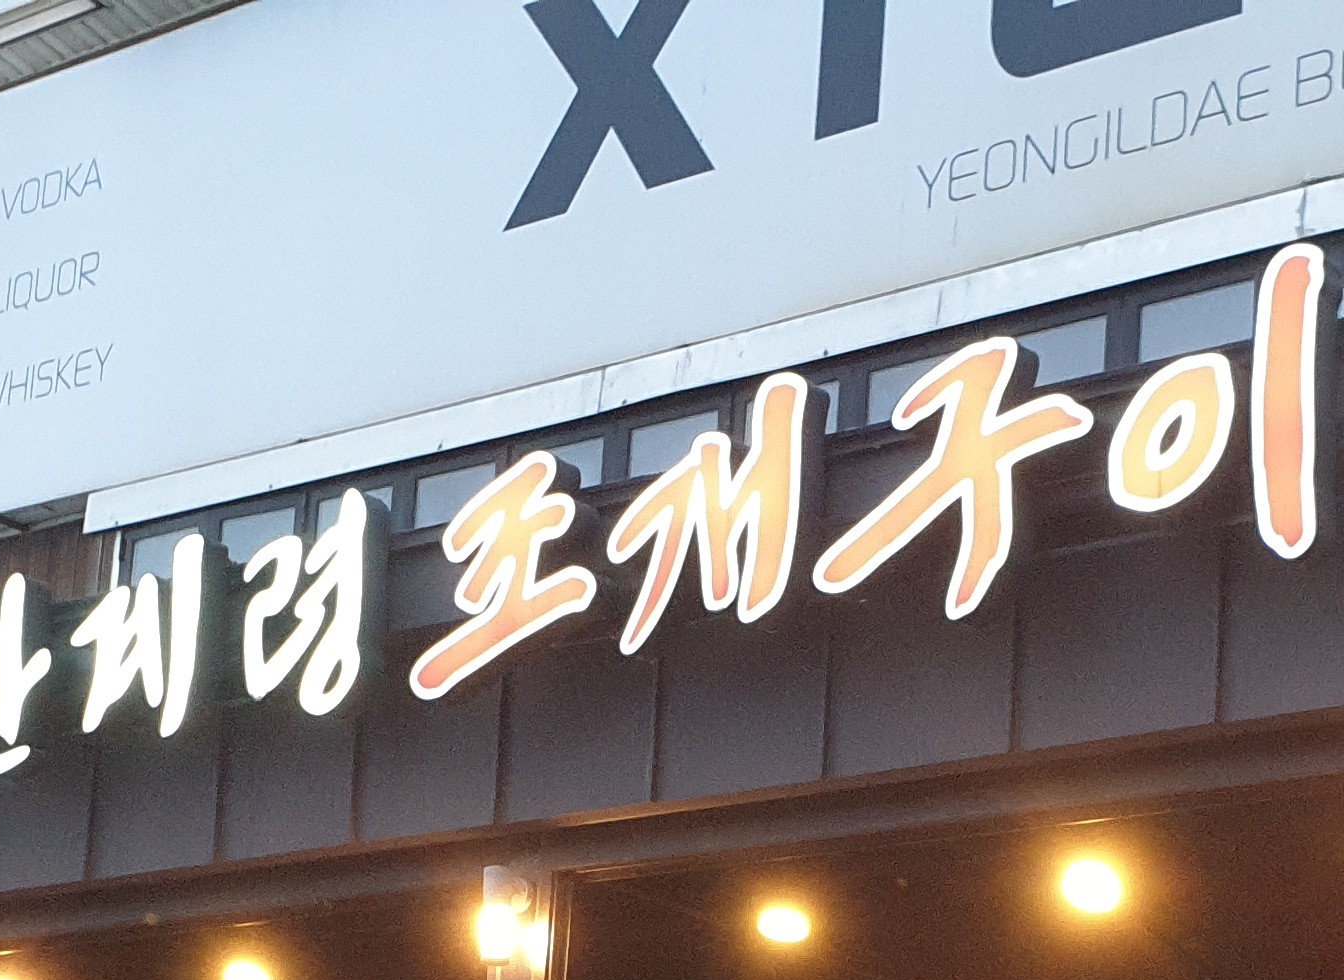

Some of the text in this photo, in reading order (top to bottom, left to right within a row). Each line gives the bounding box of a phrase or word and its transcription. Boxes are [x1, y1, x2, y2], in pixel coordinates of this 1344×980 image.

[1, 158, 102, 220] VODKA
[916, 66, 1270, 210] YEONGILDAE
[409, 242, 1327, 700] 조개구이
